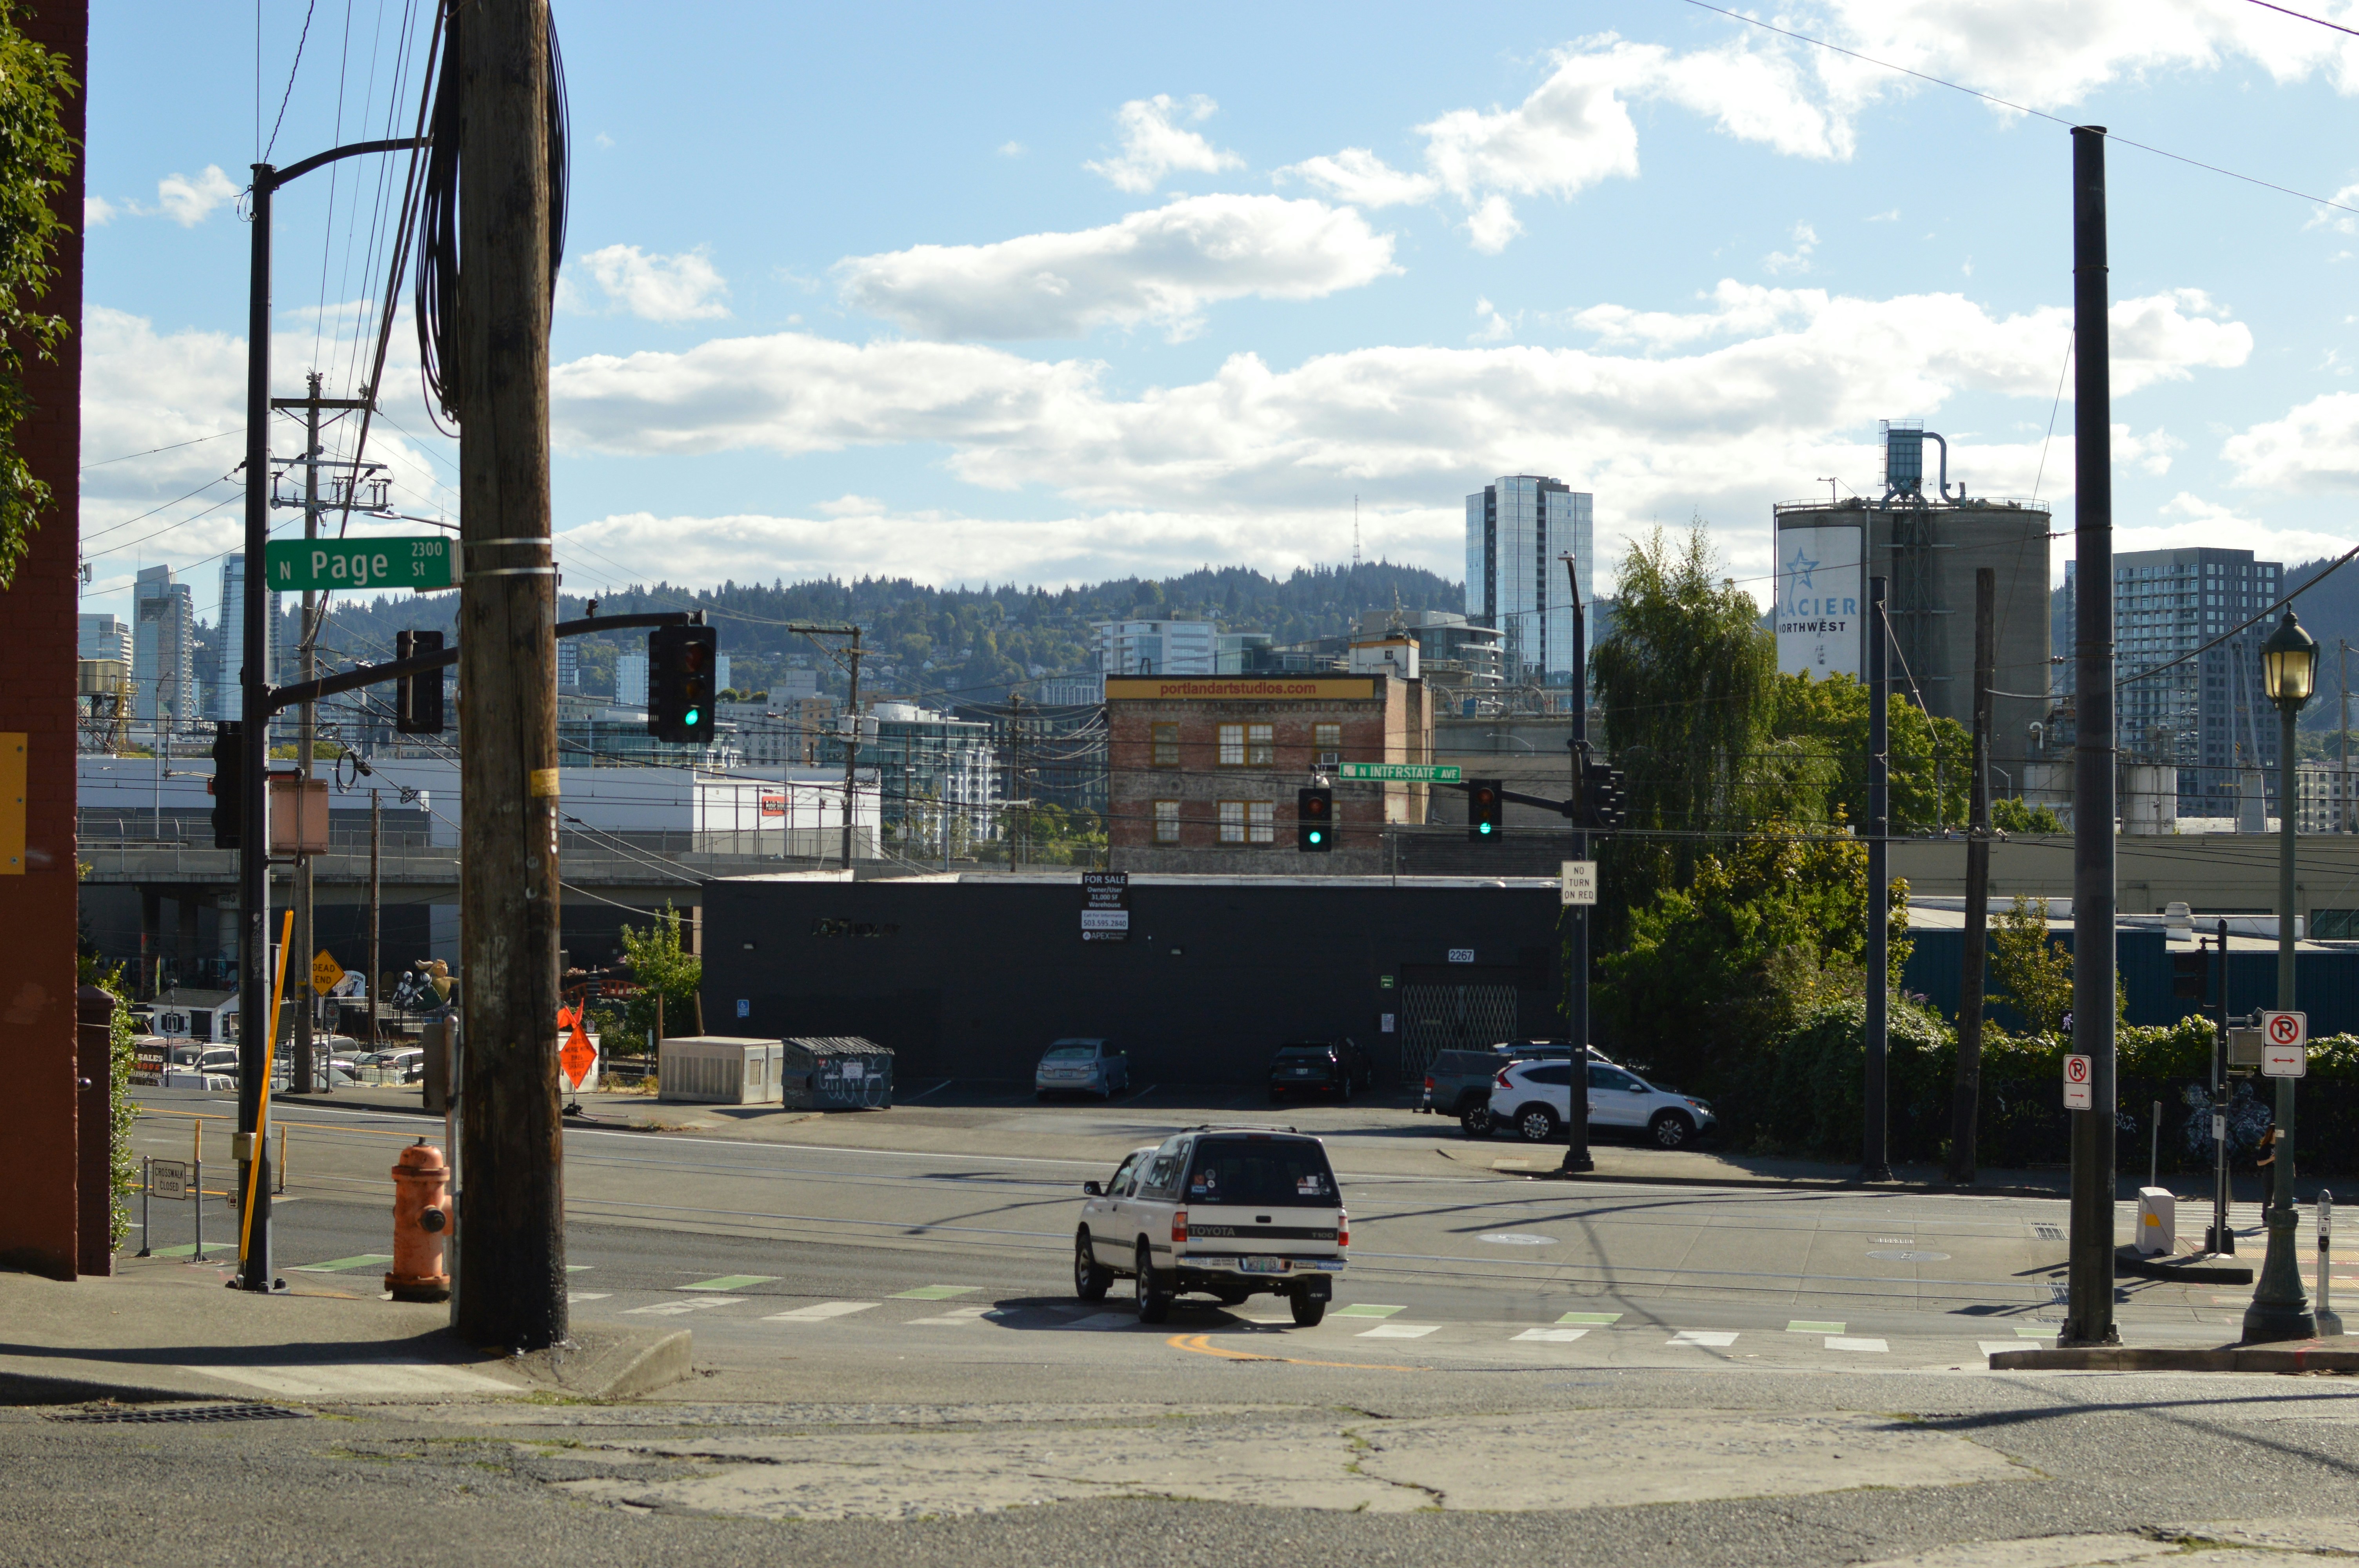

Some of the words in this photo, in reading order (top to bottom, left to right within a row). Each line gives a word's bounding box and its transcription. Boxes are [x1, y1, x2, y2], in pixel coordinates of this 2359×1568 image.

[412, 542, 443, 557] 2300
[280, 561, 291, 580] N
[312, 551, 388, 586] Page
[413, 561, 425, 576] St
[1779, 622, 1845, 633] NORTHWEST
[1161, 682, 1316, 697] portlandartstudios.com
[1359, 767, 1367, 777] N
[1370, 766, 1436, 780] INTERSTATE
[1441, 769, 1458, 779] AVE
[1085, 875, 1102, 884] FOR
[1104, 875, 1125, 884] SALE
[1565, 891, 1575, 899] ON
[1578, 891, 1594, 899] RED
[1450, 951, 1472, 960] 2267
[313, 964, 335, 972] DEAD
[315, 975, 331, 984] END
[350, 974, 363, 982] ANYON
[138, 1053, 163, 1063] SALES
[155, 1167, 184, 1179] CROSSWALK
[160, 1181, 179, 1191] CLOSED
[1190, 1226, 1235, 1236] TOYOTA
